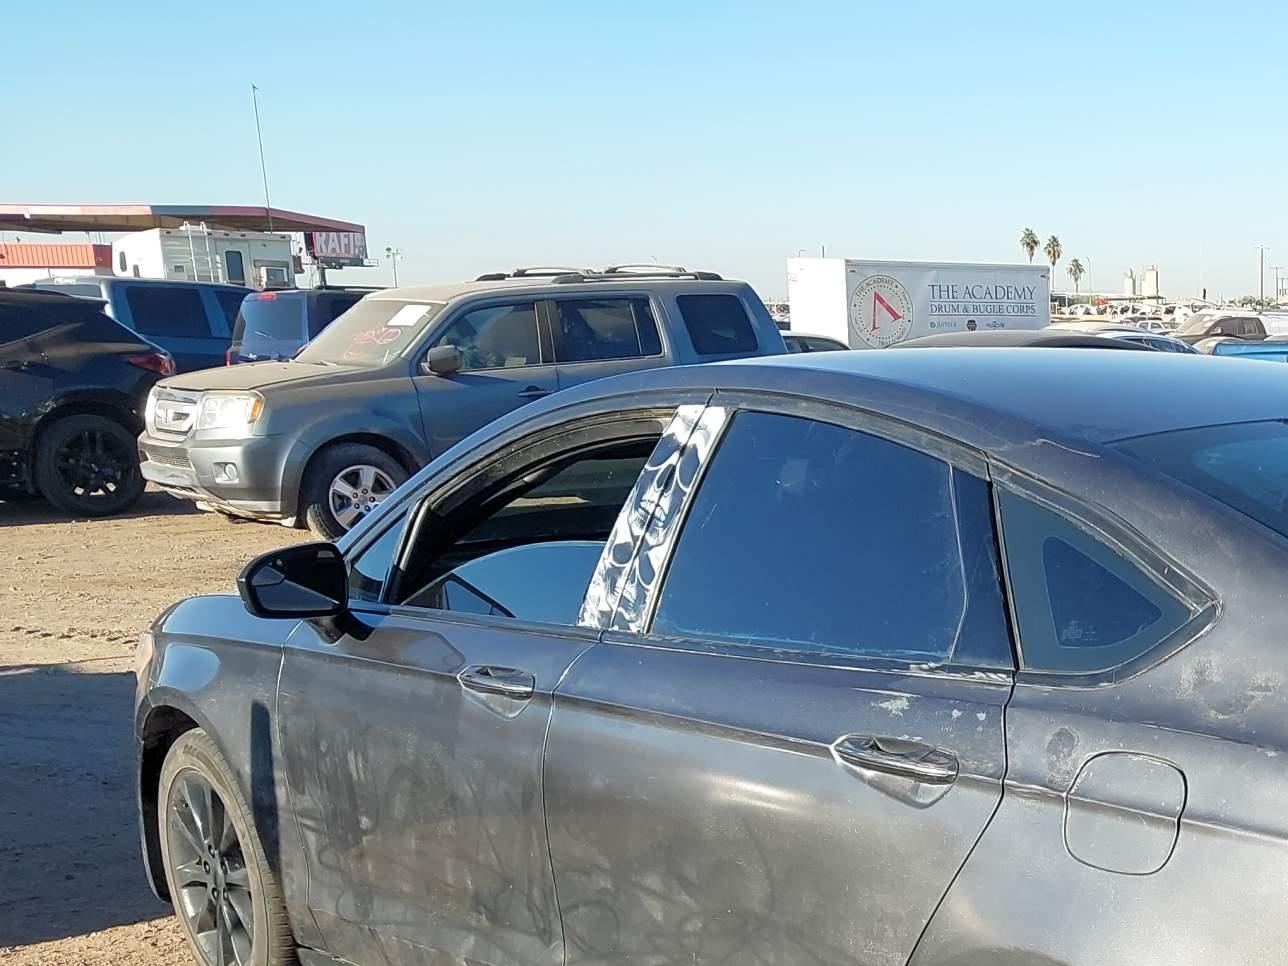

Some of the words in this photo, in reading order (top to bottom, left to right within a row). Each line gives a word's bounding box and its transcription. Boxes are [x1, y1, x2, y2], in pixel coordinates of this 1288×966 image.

[928, 284, 958, 300] THE
[963, 284, 1037, 301] ACADEMY
[930, 303, 959, 314] DRUM
[961, 303, 970, 314] &
[972, 304, 1004, 314] BUGLE
[1006, 304, 1036, 314] CORPS
